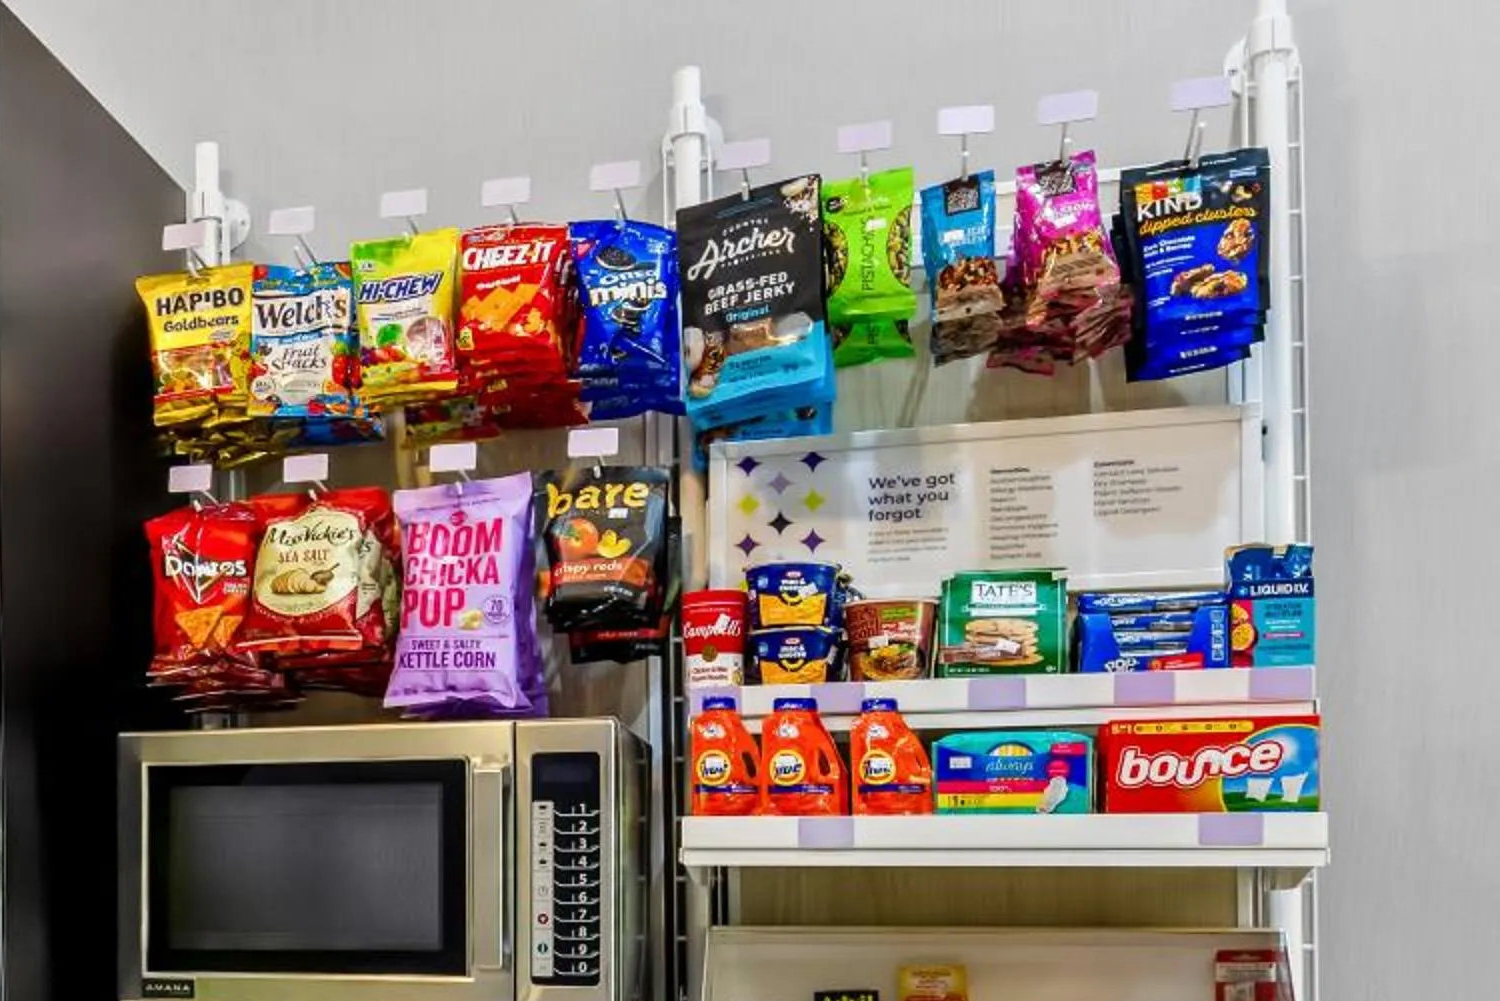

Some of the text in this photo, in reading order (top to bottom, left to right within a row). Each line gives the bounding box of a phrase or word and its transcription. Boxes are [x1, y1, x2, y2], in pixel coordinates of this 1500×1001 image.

[1137, 191, 1203, 222] KIND
[1140, 205, 1257, 236] dipped clusters
[462, 240, 557, 271] CHEEZ-IT
[687, 226, 796, 281] Archer
[359, 271, 444, 300] HI-CHEW
[589, 279, 668, 307] minis
[707, 271, 789, 301] GRASS-FED
[704, 281, 795, 316] BEEF JERKY
[255, 293, 348, 330] Welch's
[163, 314, 240, 334] Goldbears
[868, 473, 956, 490] We've got
[546, 481, 650, 520] bare
[867, 491, 950, 506] what you
[407, 517, 504, 558] BOOM
[277, 548, 331, 565] SEA SALT
[404, 554, 501, 587] CHICKA
[975, 583, 1034, 597] TATE'S
[401, 587, 466, 630] POP
[411, 639, 441, 650] SWEET
[399, 651, 497, 669] KETTLE CORN
[1120, 739, 1283, 789] bounce
[579, 804, 587, 814] 1
[579, 821, 587, 832] 2
[579, 838, 587, 849] 3
[579, 856, 587, 867] 4
[579, 874, 587, 885] 5
[579, 891, 587, 902] 6
[579, 909, 587, 920] 7
[579, 927, 587, 937] 8
[579, 944, 587, 955] 9
[579, 962, 587, 973] 0
[145, 983, 192, 993] AMANA
